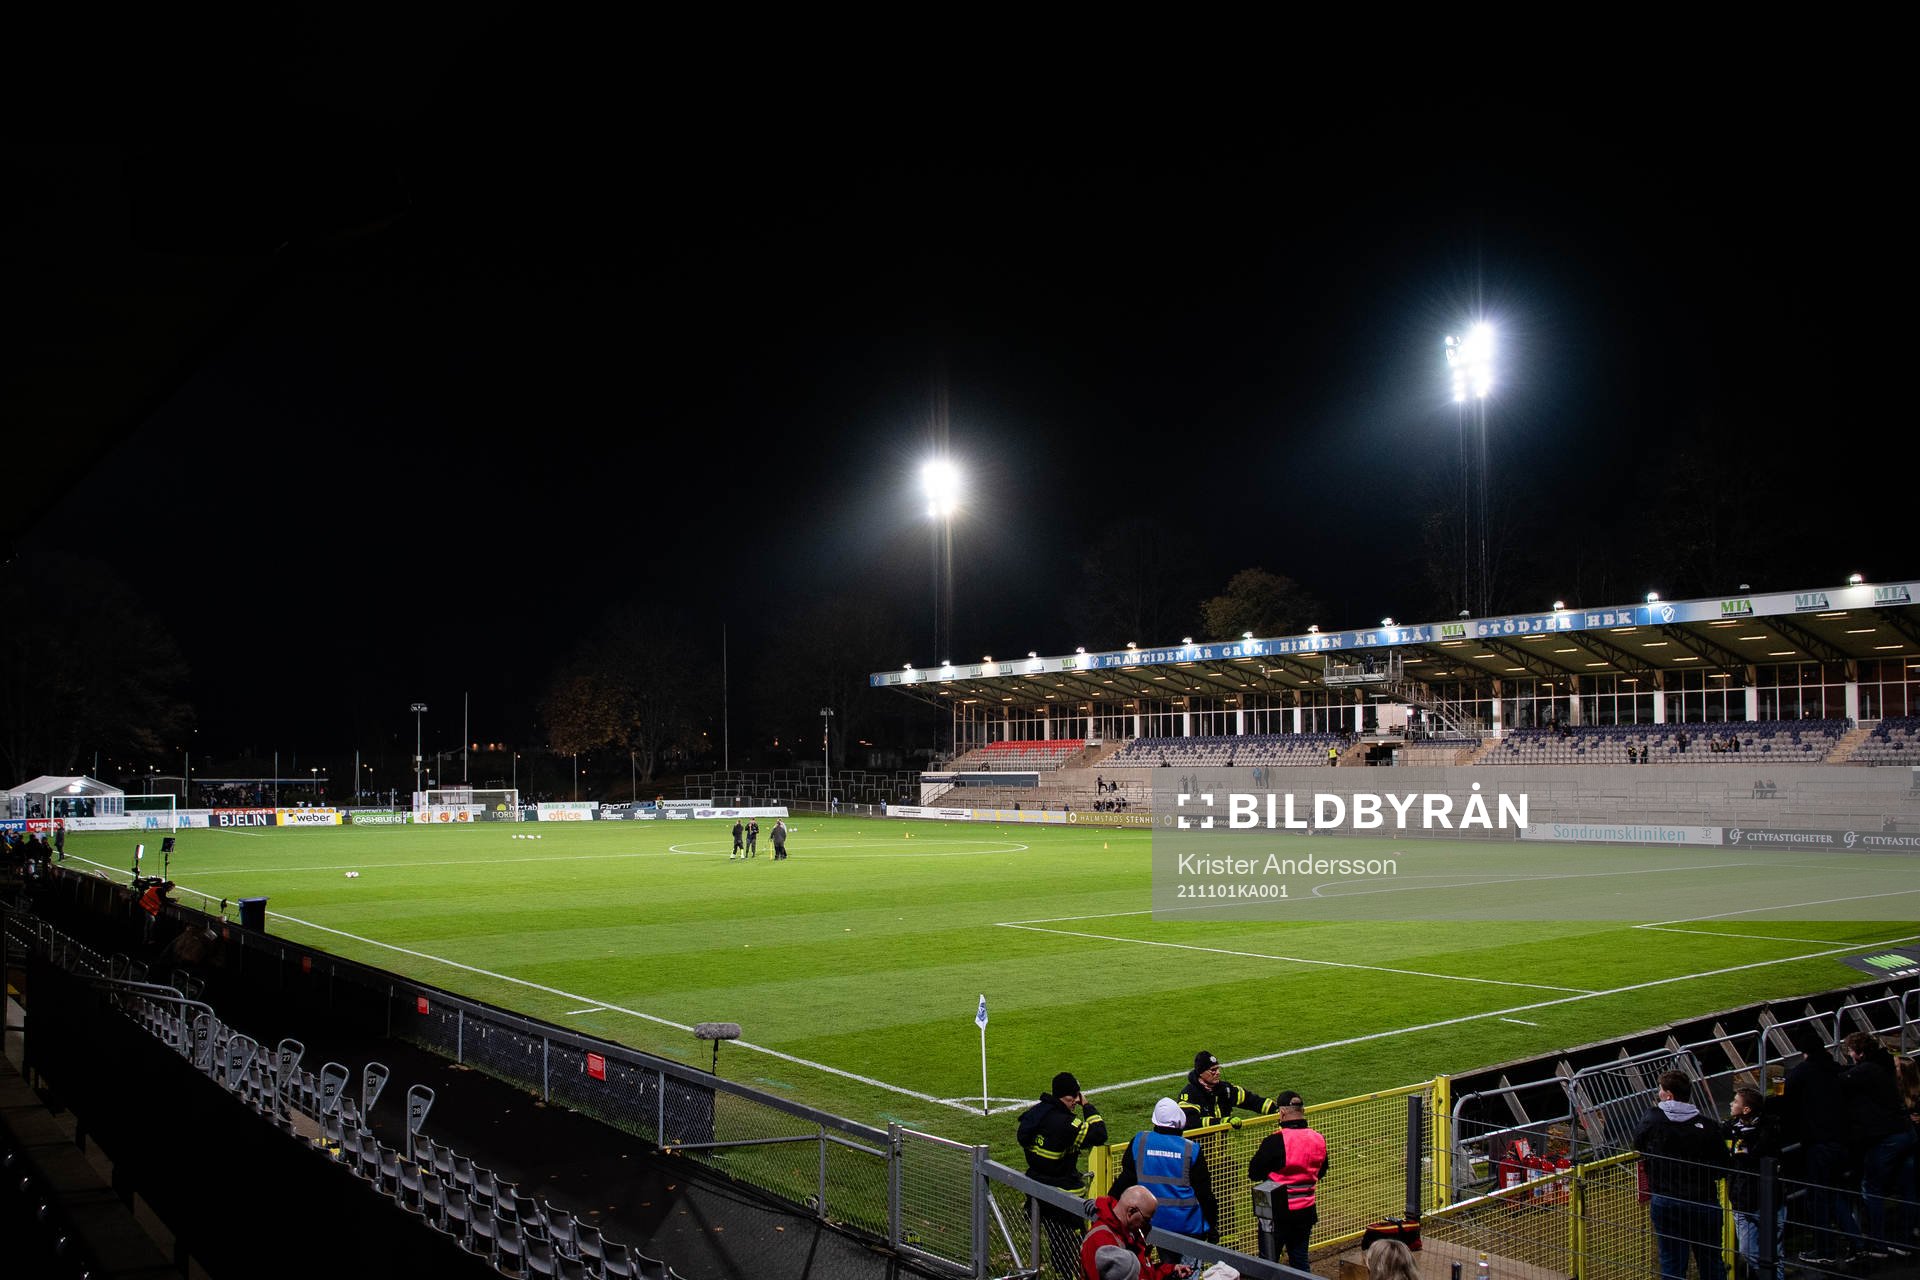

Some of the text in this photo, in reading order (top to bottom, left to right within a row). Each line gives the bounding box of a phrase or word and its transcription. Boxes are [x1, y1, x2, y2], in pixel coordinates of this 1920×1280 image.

[1794, 592, 1830, 607] MTA
[1874, 586, 1911, 601] MTA
[1721, 600, 1751, 613] MTA
[1442, 624, 1466, 636] MTA
[1478, 612, 1632, 636] STÖDJER HBK
[1106, 650, 1184, 666] FRAMTIDEN
[1280, 636, 1342, 652] HIMLEN
[220, 814, 267, 827] BJELIN
[297, 813, 331, 822] weber
[548, 809, 581, 821] office
[1125, 815, 1160, 825] STENHUS
[1553, 824, 1686, 841] Söndrumskliniken
[1746, 832, 1834, 844] CITYFASTIGHETER
